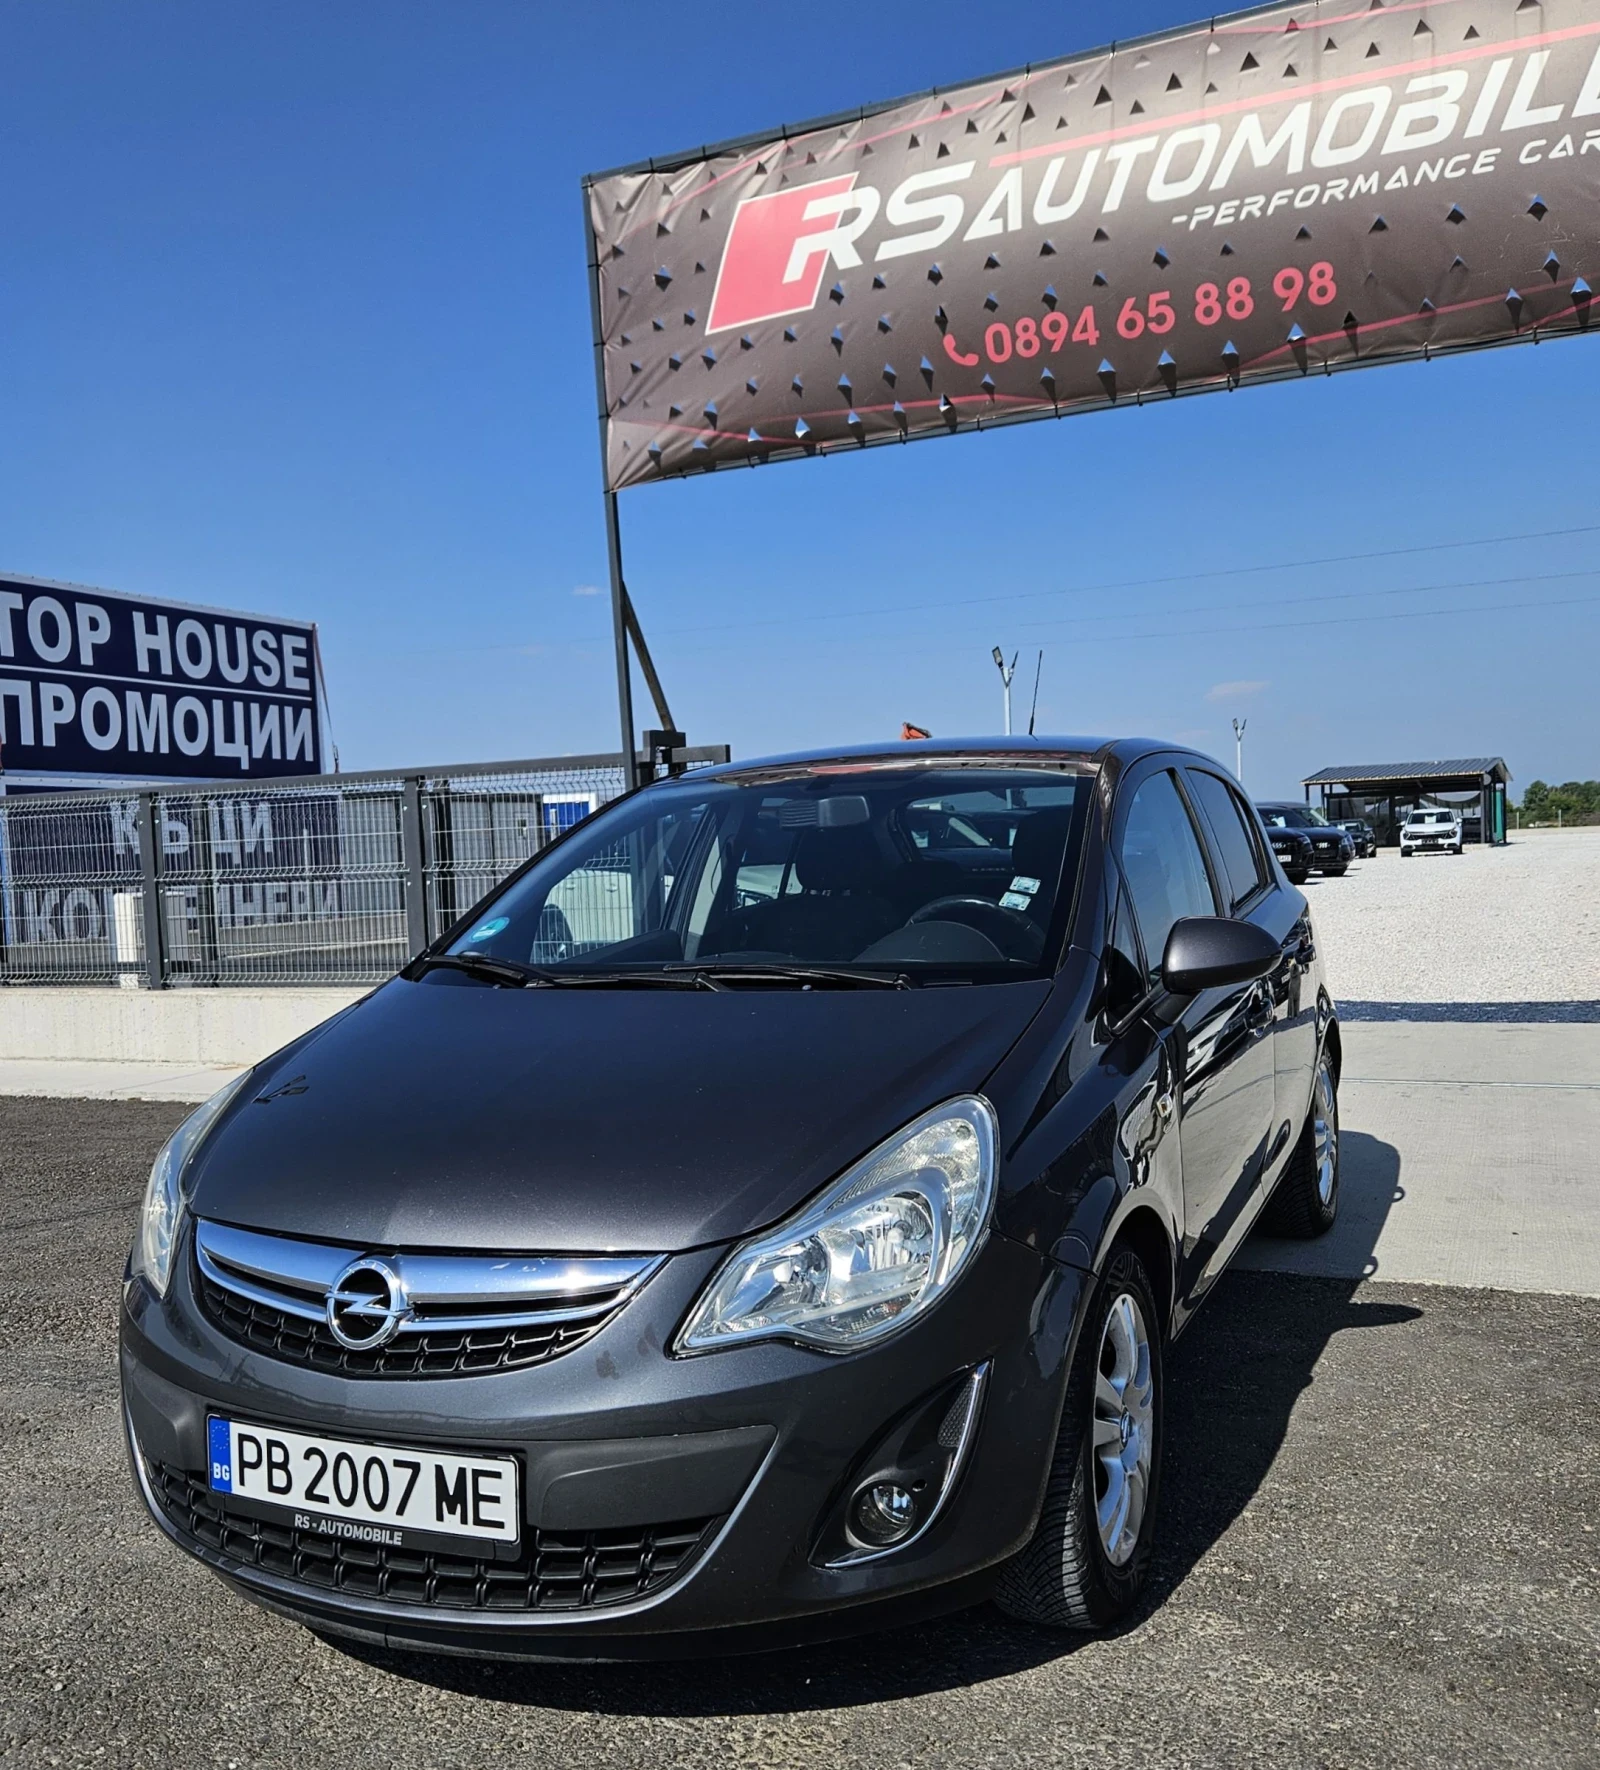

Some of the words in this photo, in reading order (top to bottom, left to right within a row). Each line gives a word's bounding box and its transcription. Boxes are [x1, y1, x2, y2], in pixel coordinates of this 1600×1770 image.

[984, 305, 1100, 364] 0894
[1115, 290, 1176, 340] 65
[1193, 277, 1255, 327] 88
[1272, 262, 1338, 312] 98
[0, 590, 111, 666] TOP
[132, 611, 311, 691] HOUSE
[0, 678, 314, 770] ПРОМОЦИИ
[213, 1461, 231, 1481] BG
[237, 1432, 293, 1496] PB
[303, 1446, 421, 1517] 2007
[434, 1464, 505, 1530] ME
[294, 1513, 310, 1529] RS
[318, 1519, 403, 1546] AUTOMOBILE
